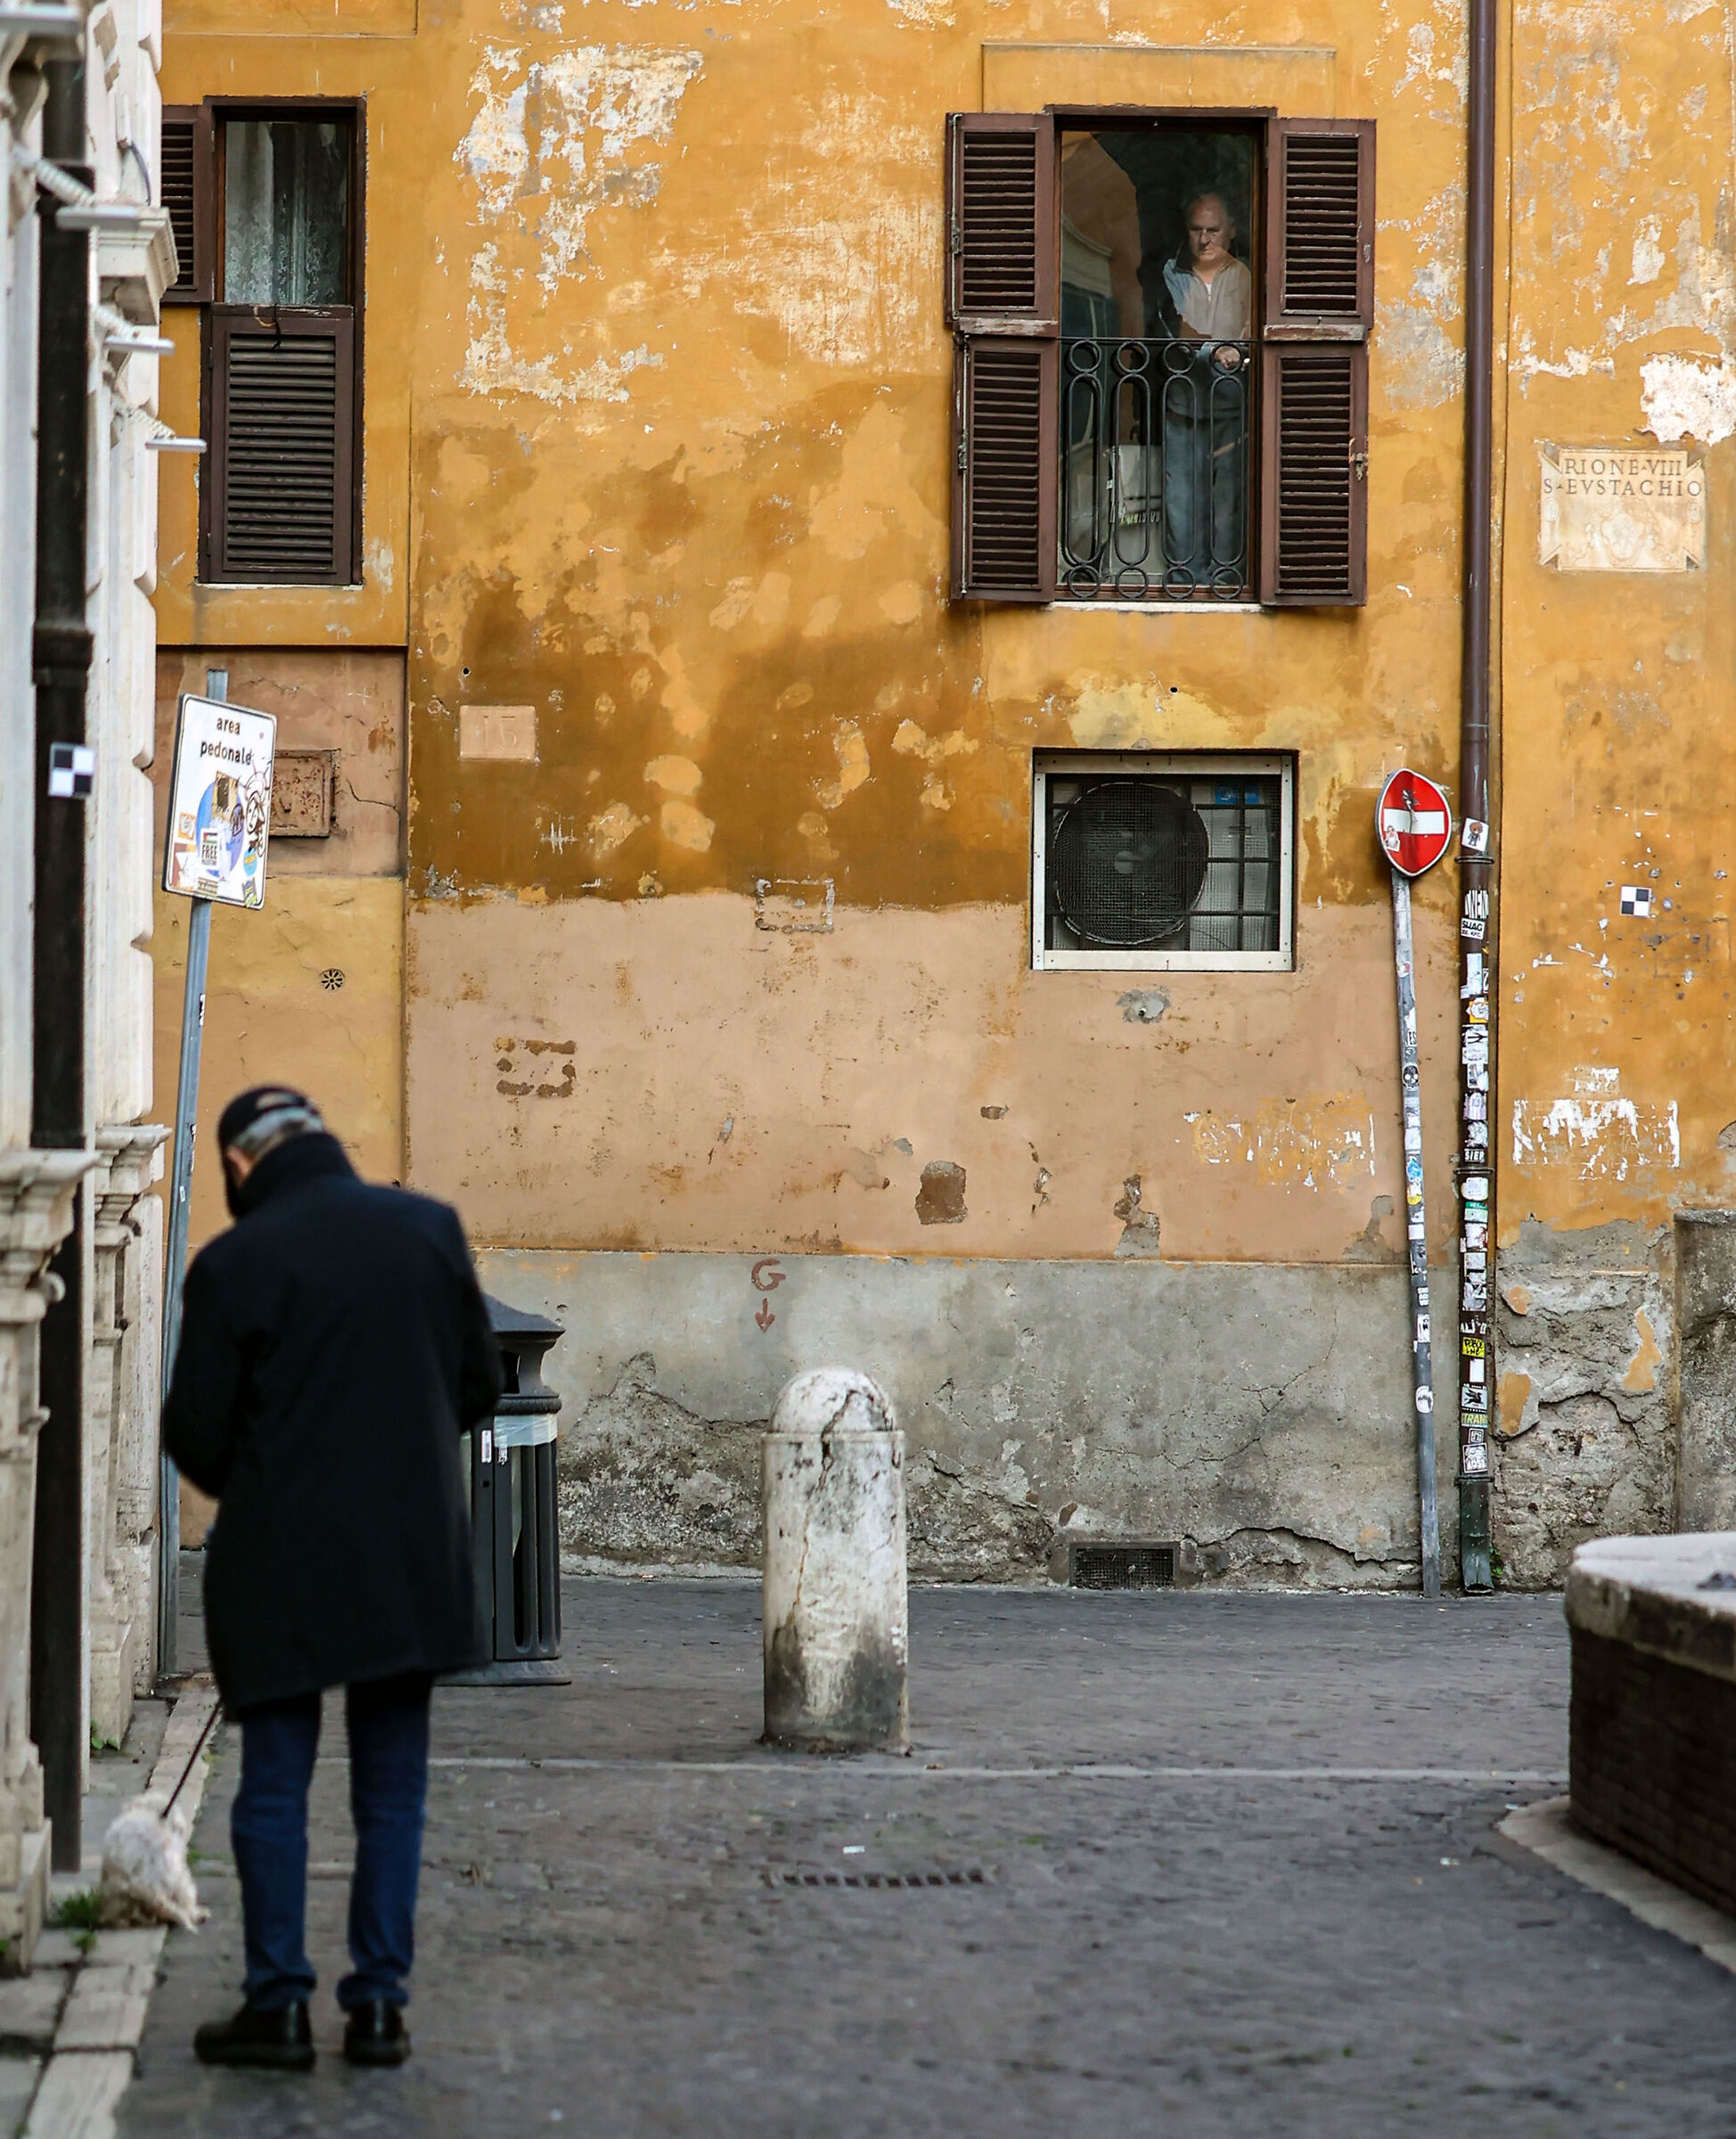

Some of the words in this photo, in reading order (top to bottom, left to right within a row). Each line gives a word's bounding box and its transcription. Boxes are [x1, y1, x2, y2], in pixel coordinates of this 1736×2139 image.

[1564, 458, 1639, 476] RIONE
[1566, 479, 1701, 496] EVSTACHIO
[217, 717, 241, 735] area
[200, 741, 252, 766] pedonale
[751, 1258, 786, 1291] G
